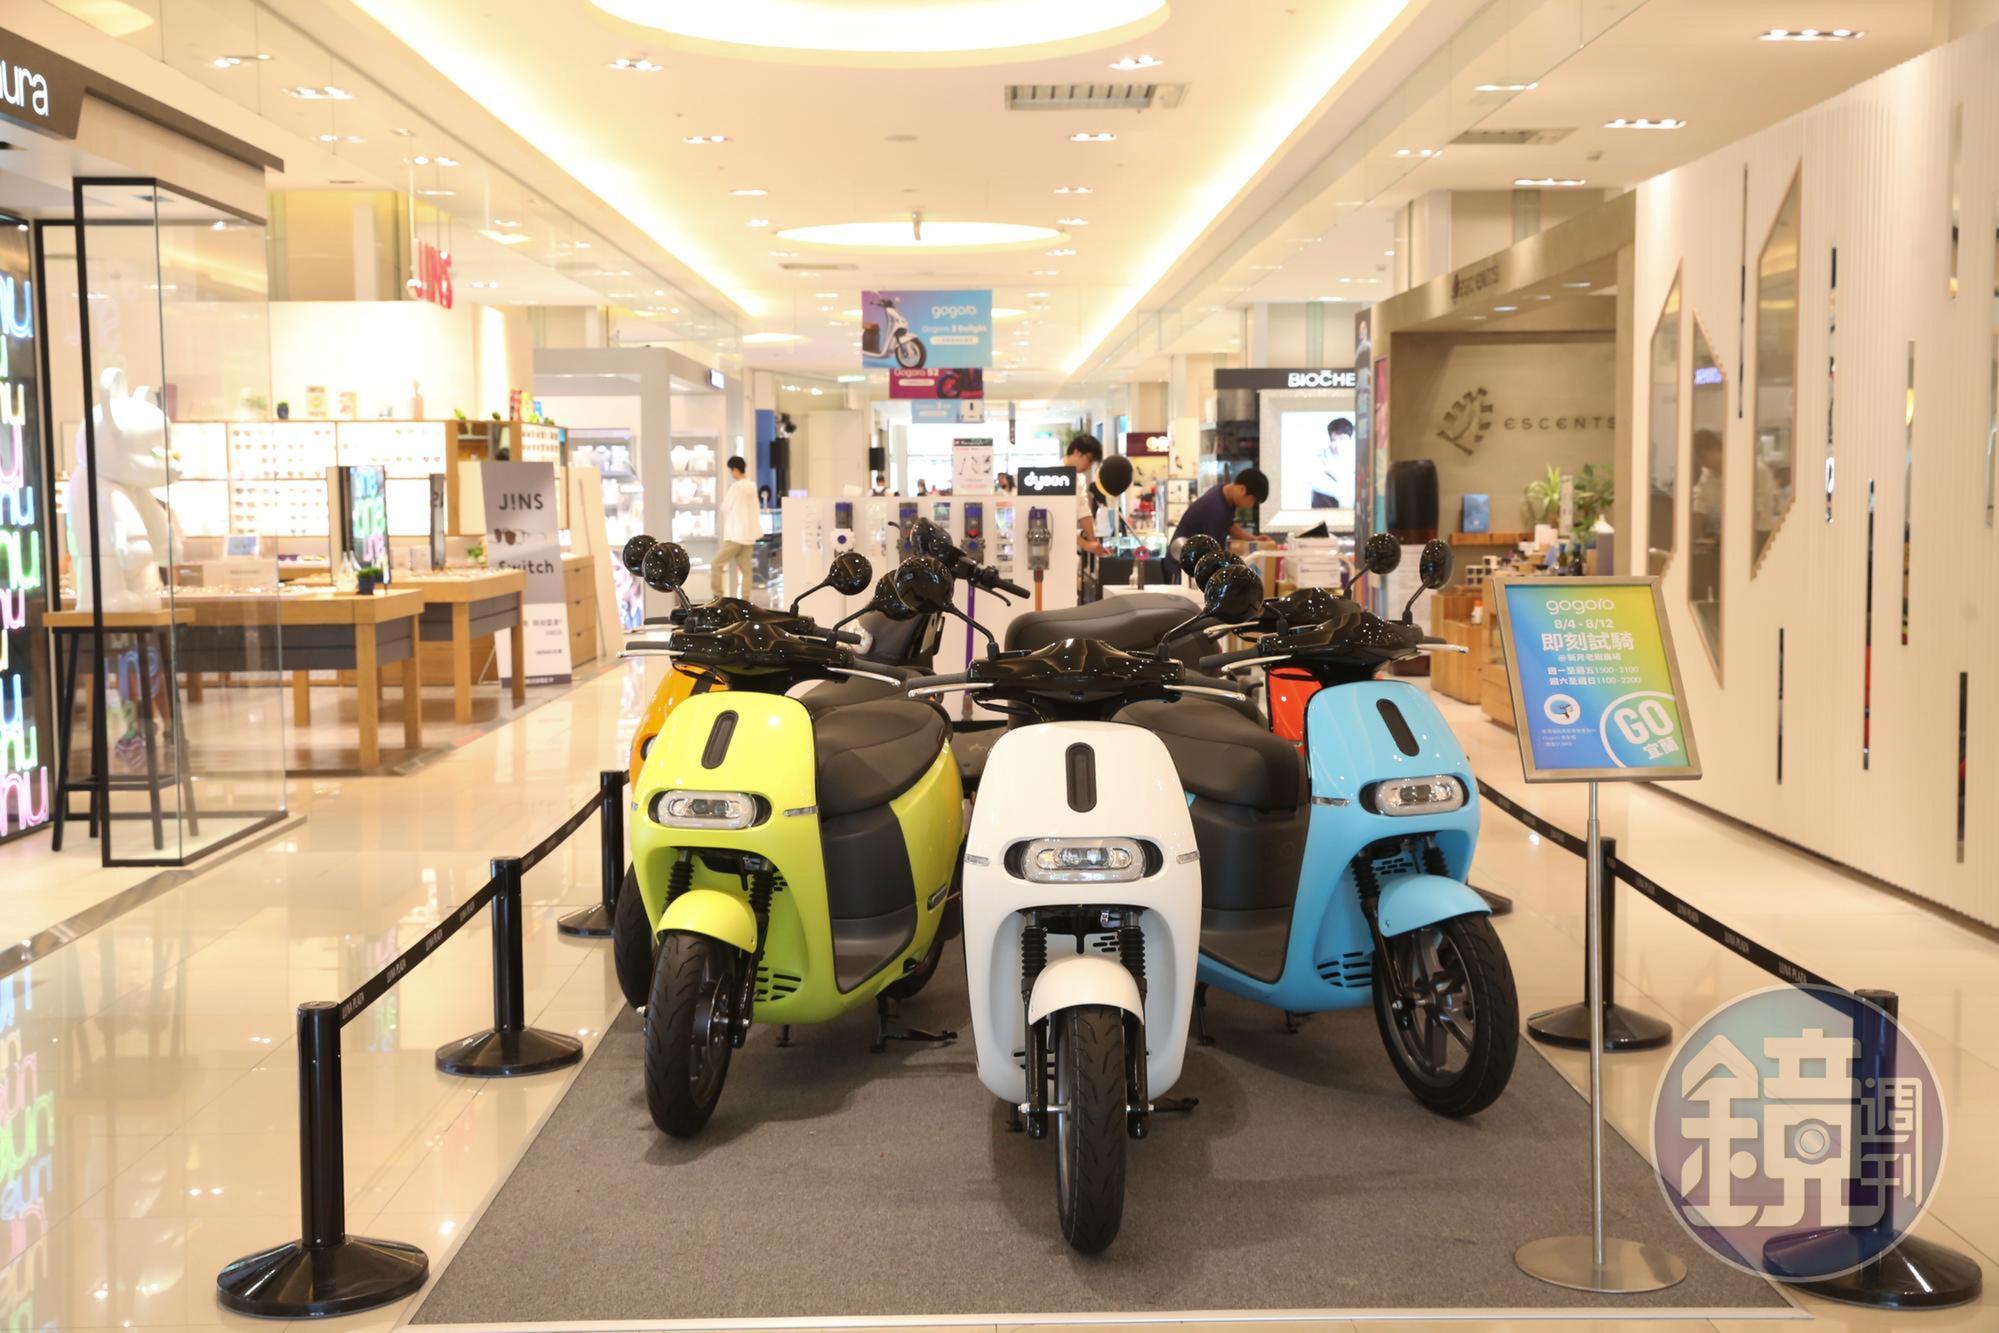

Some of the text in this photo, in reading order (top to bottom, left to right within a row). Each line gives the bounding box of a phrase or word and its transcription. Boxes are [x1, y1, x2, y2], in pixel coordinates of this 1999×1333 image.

[0, 60, 49, 116] ura
[1023, 471, 1071, 491] dyson
[1546, 598, 1615, 615] gogoro
[1554, 618, 1576, 631] 8/4
[1585, 617, 1614, 630] 8/12
[1541, 631, 1634, 652] 即刻試騎
[1613, 699, 1675, 745] GO
